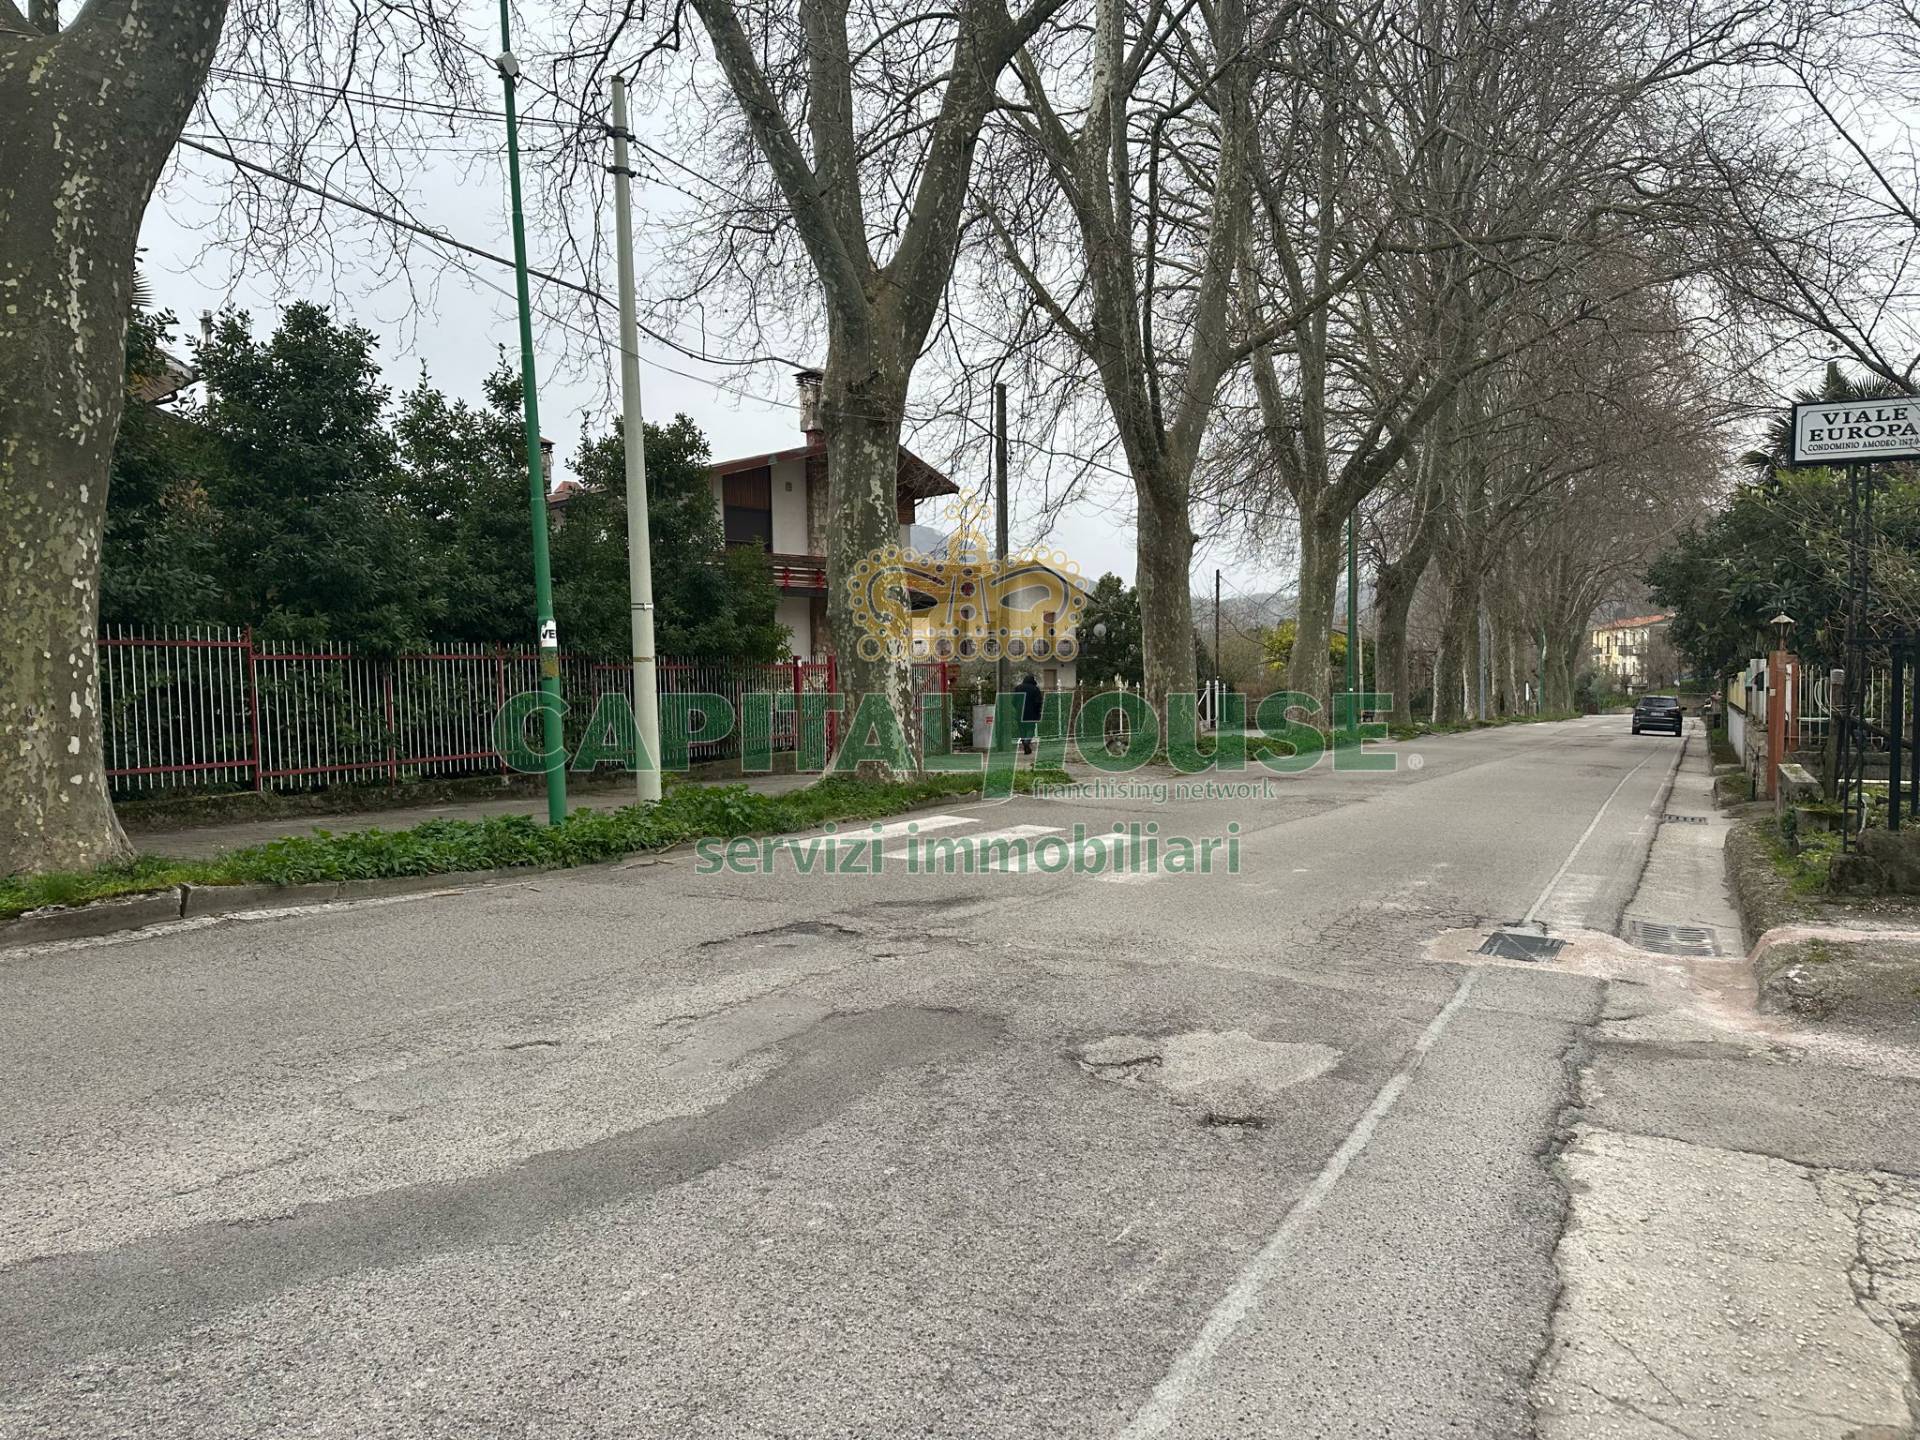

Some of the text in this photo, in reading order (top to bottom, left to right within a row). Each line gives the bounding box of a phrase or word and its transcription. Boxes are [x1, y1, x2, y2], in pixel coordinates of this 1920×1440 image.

[1822, 407, 1908, 425] VIALE
[1809, 423, 1919, 442] EUROPA
[1807, 441, 1860, 452] CONDOMINIO
[1862, 439, 1897, 449] AMODEO
